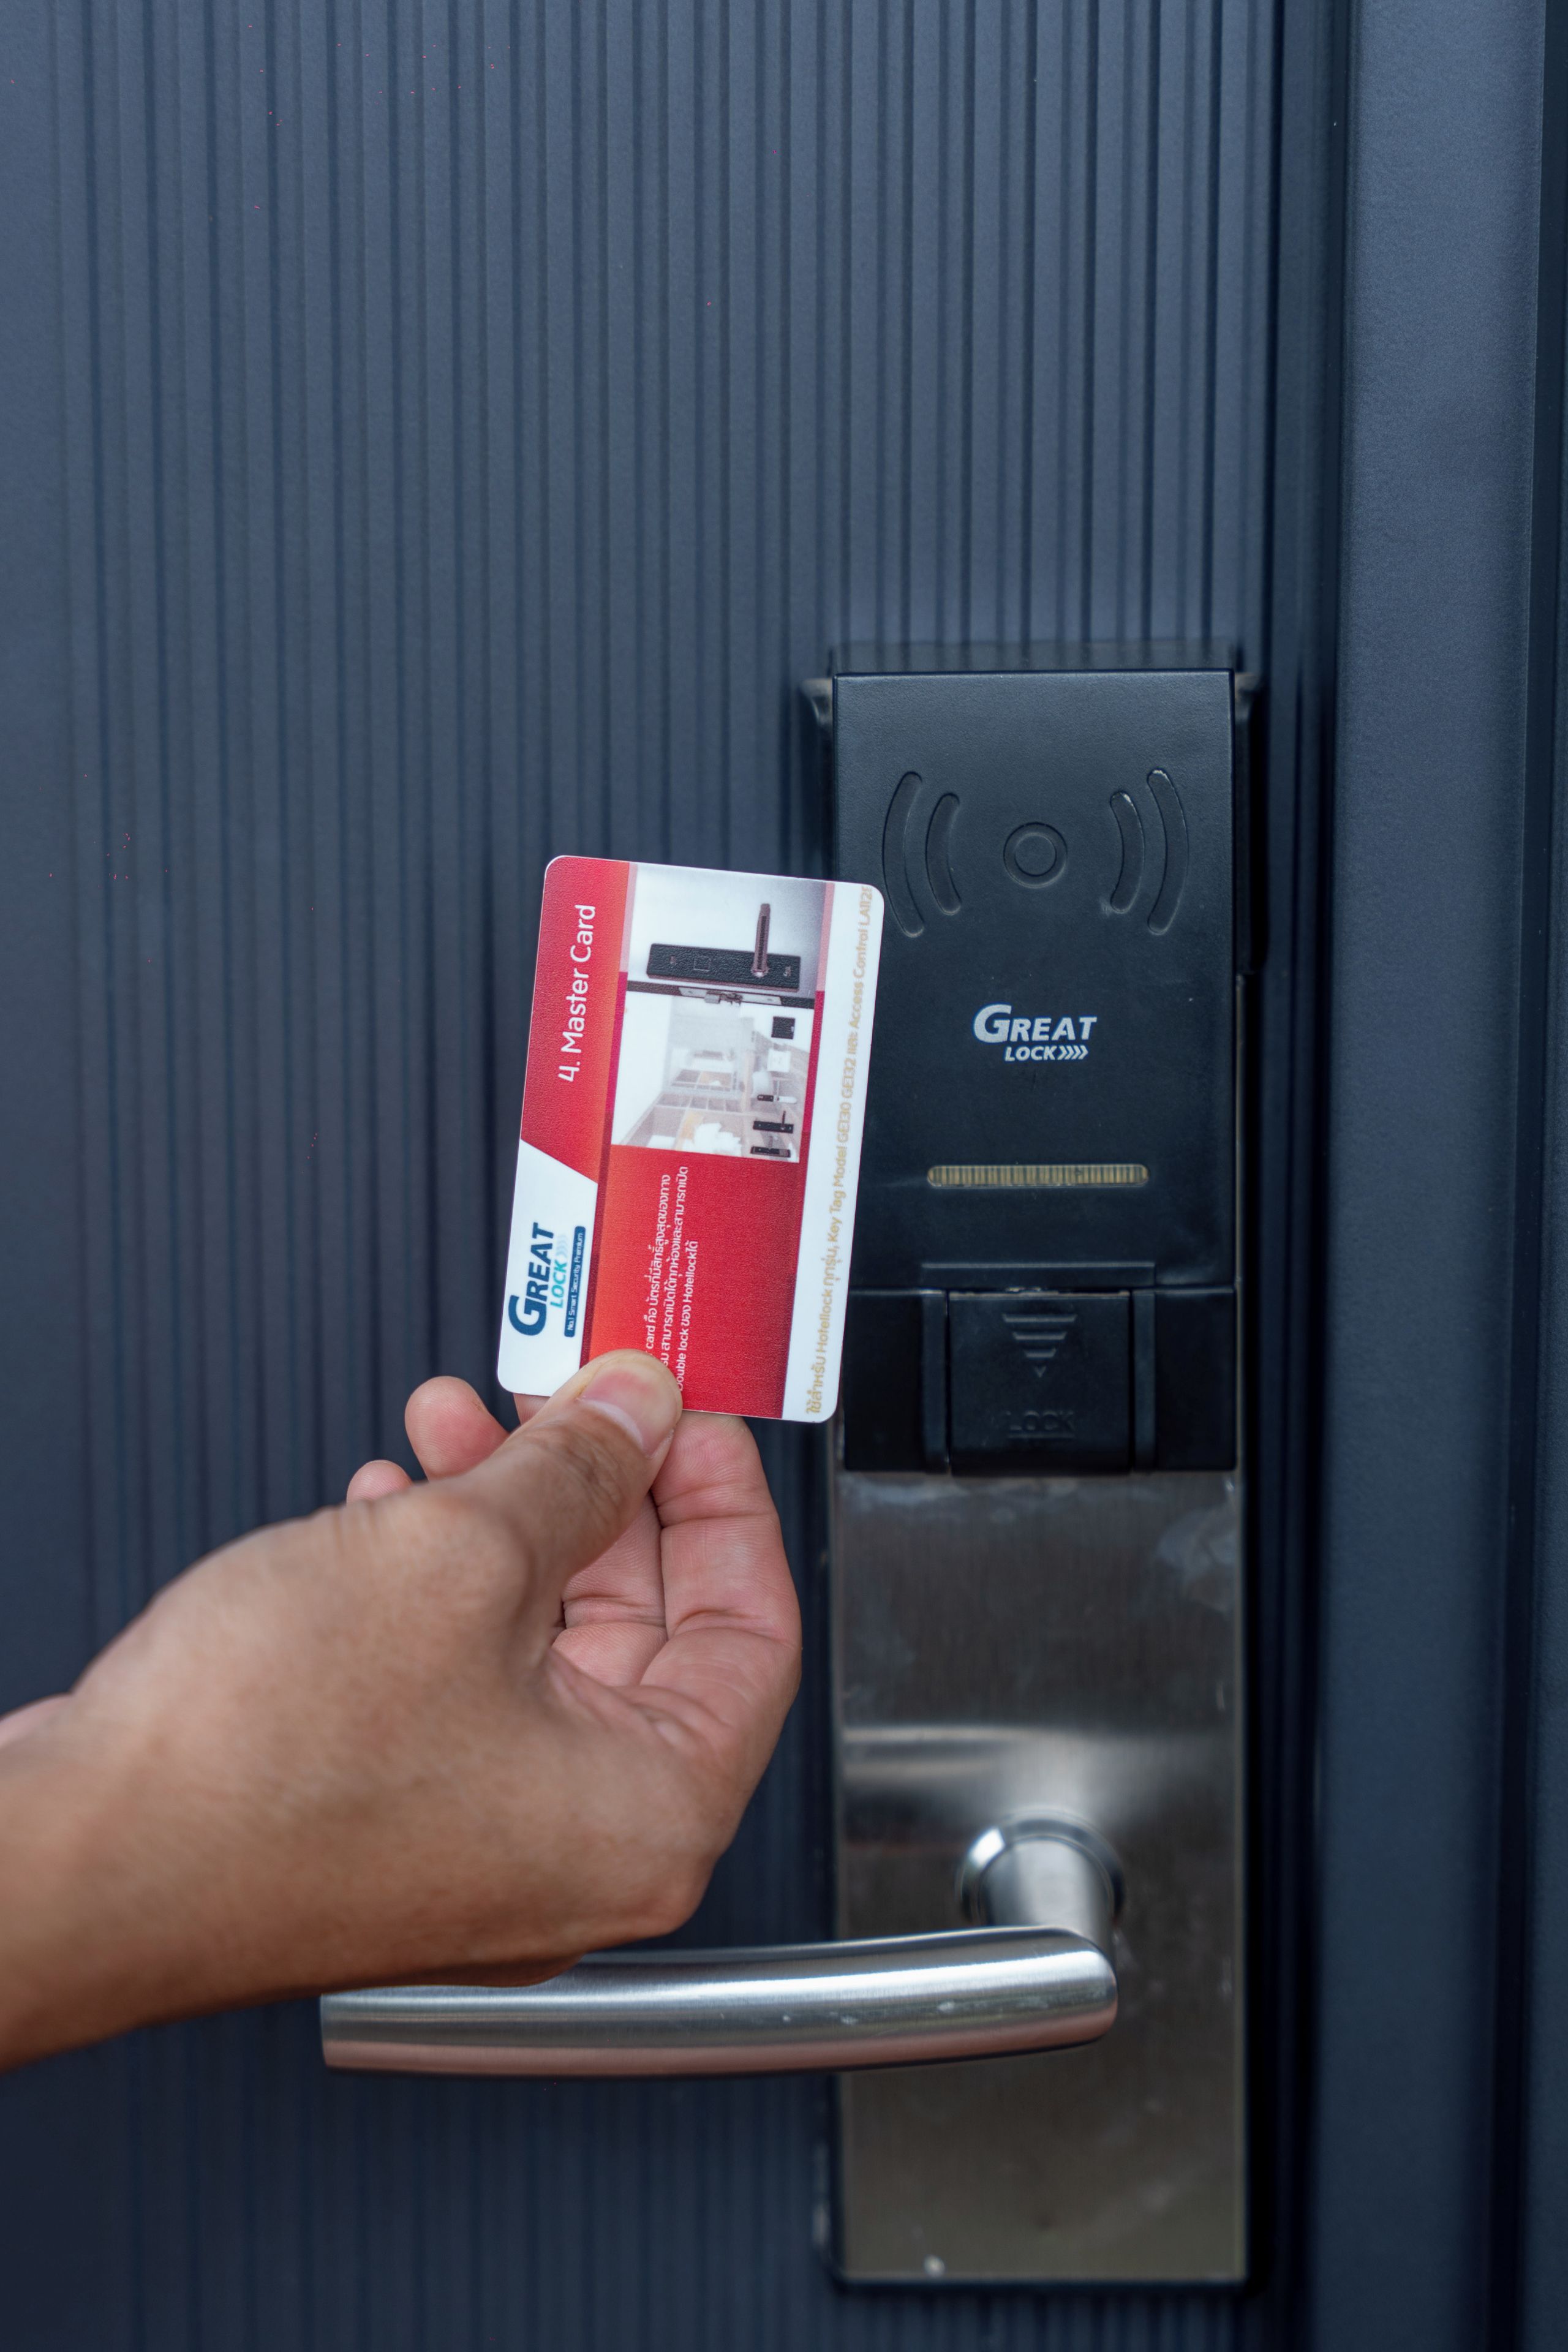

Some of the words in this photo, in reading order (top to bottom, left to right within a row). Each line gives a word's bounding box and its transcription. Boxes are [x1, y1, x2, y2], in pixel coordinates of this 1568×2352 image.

[570, 905, 595, 962] Card
[853, 929, 869, 979] Control
[560, 968, 589, 1054] Master
[849, 982, 864, 1029] Access
[974, 1004, 1098, 1043] GREAT
[1005, 1046, 1058, 1062] LOCK
[558, 1061, 581, 1082] 4.
[833, 1146, 846, 1187] Model
[829, 1190, 846, 1213] Tag
[827, 1216, 842, 1242] Key
[574, 1232, 582, 1263] Premium
[508, 1222, 554, 1336] GREAT
[550, 1259, 567, 1308] LOCK
[571, 1264, 581, 1292] Security
[568, 1295, 577, 1316] Smart
[643, 1307, 657, 1323] คือ
[680, 1304, 692, 1327] ของ
[816, 1289, 832, 1353] Hotellock
[646, 1325, 655, 1349] card
[677, 1329, 688, 1351] lock
